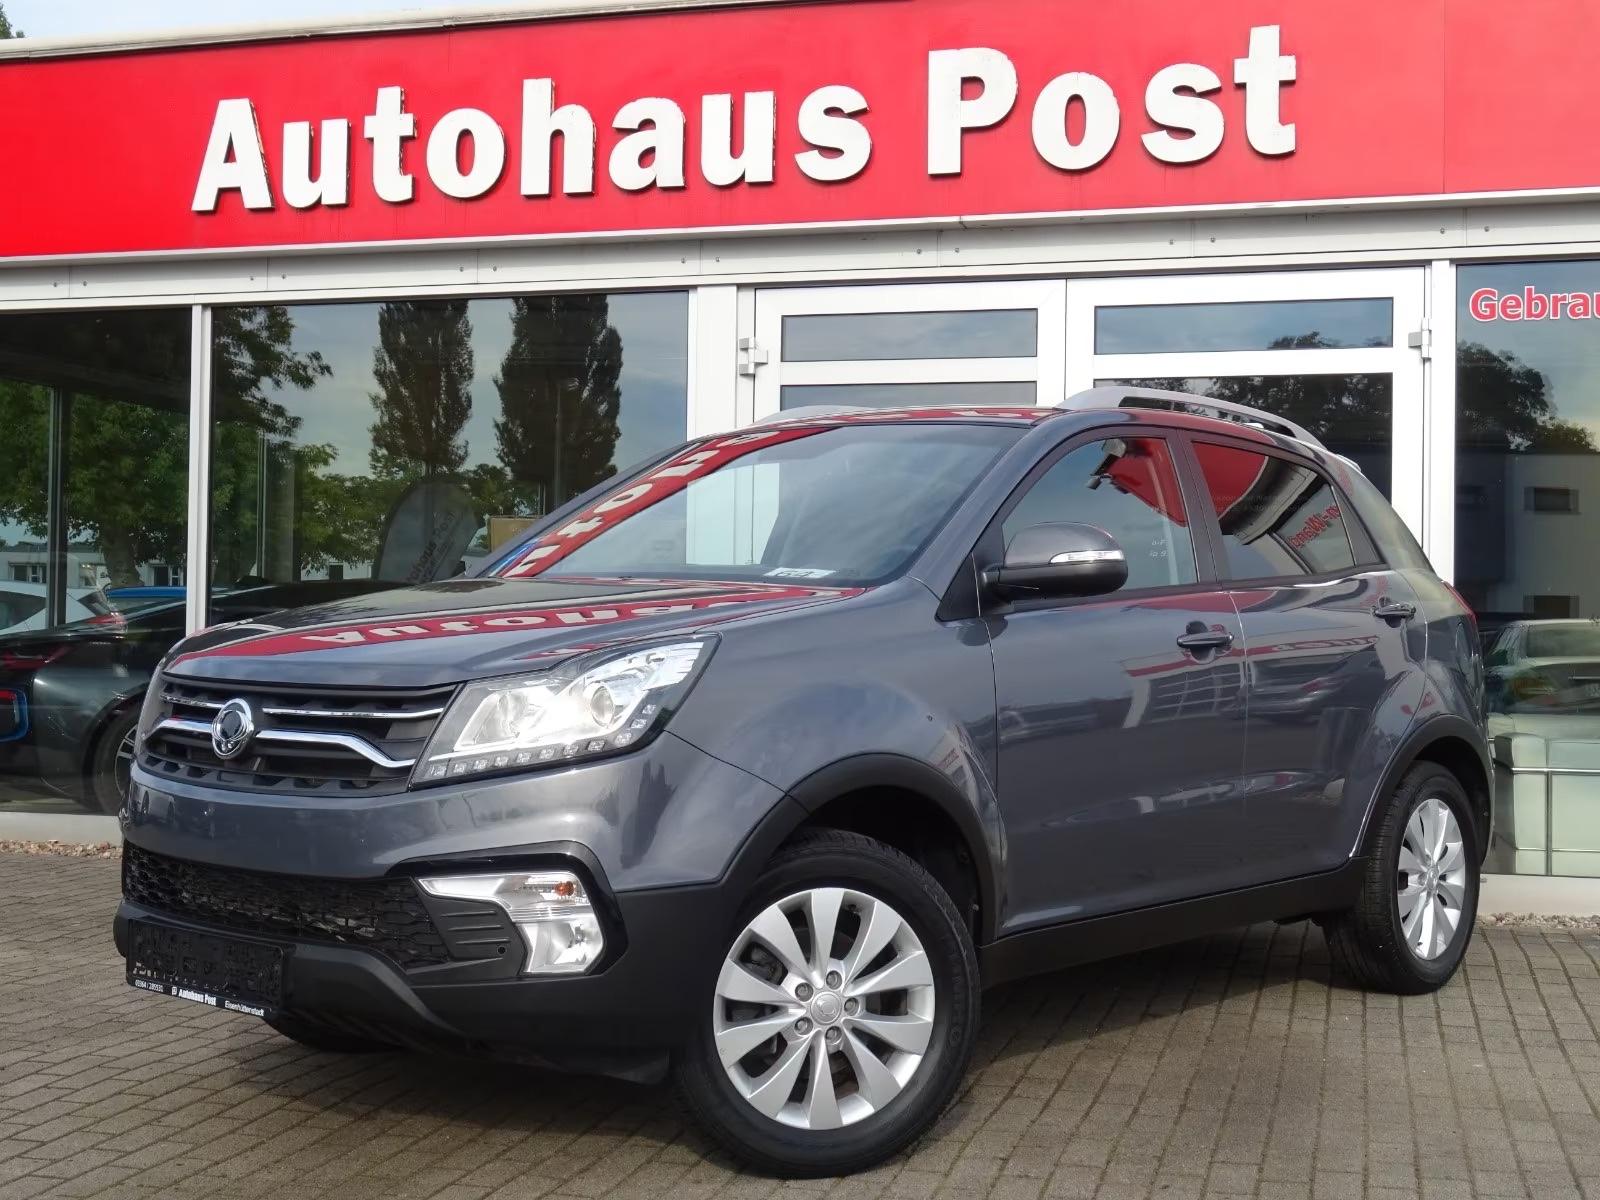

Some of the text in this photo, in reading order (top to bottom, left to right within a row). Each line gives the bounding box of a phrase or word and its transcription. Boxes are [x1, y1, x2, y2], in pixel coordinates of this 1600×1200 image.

[192, 25, 1298, 212] Autohaus Post
[178, 988, 204, 1003] Autohaus
[204, 993, 216, 1007] Post
